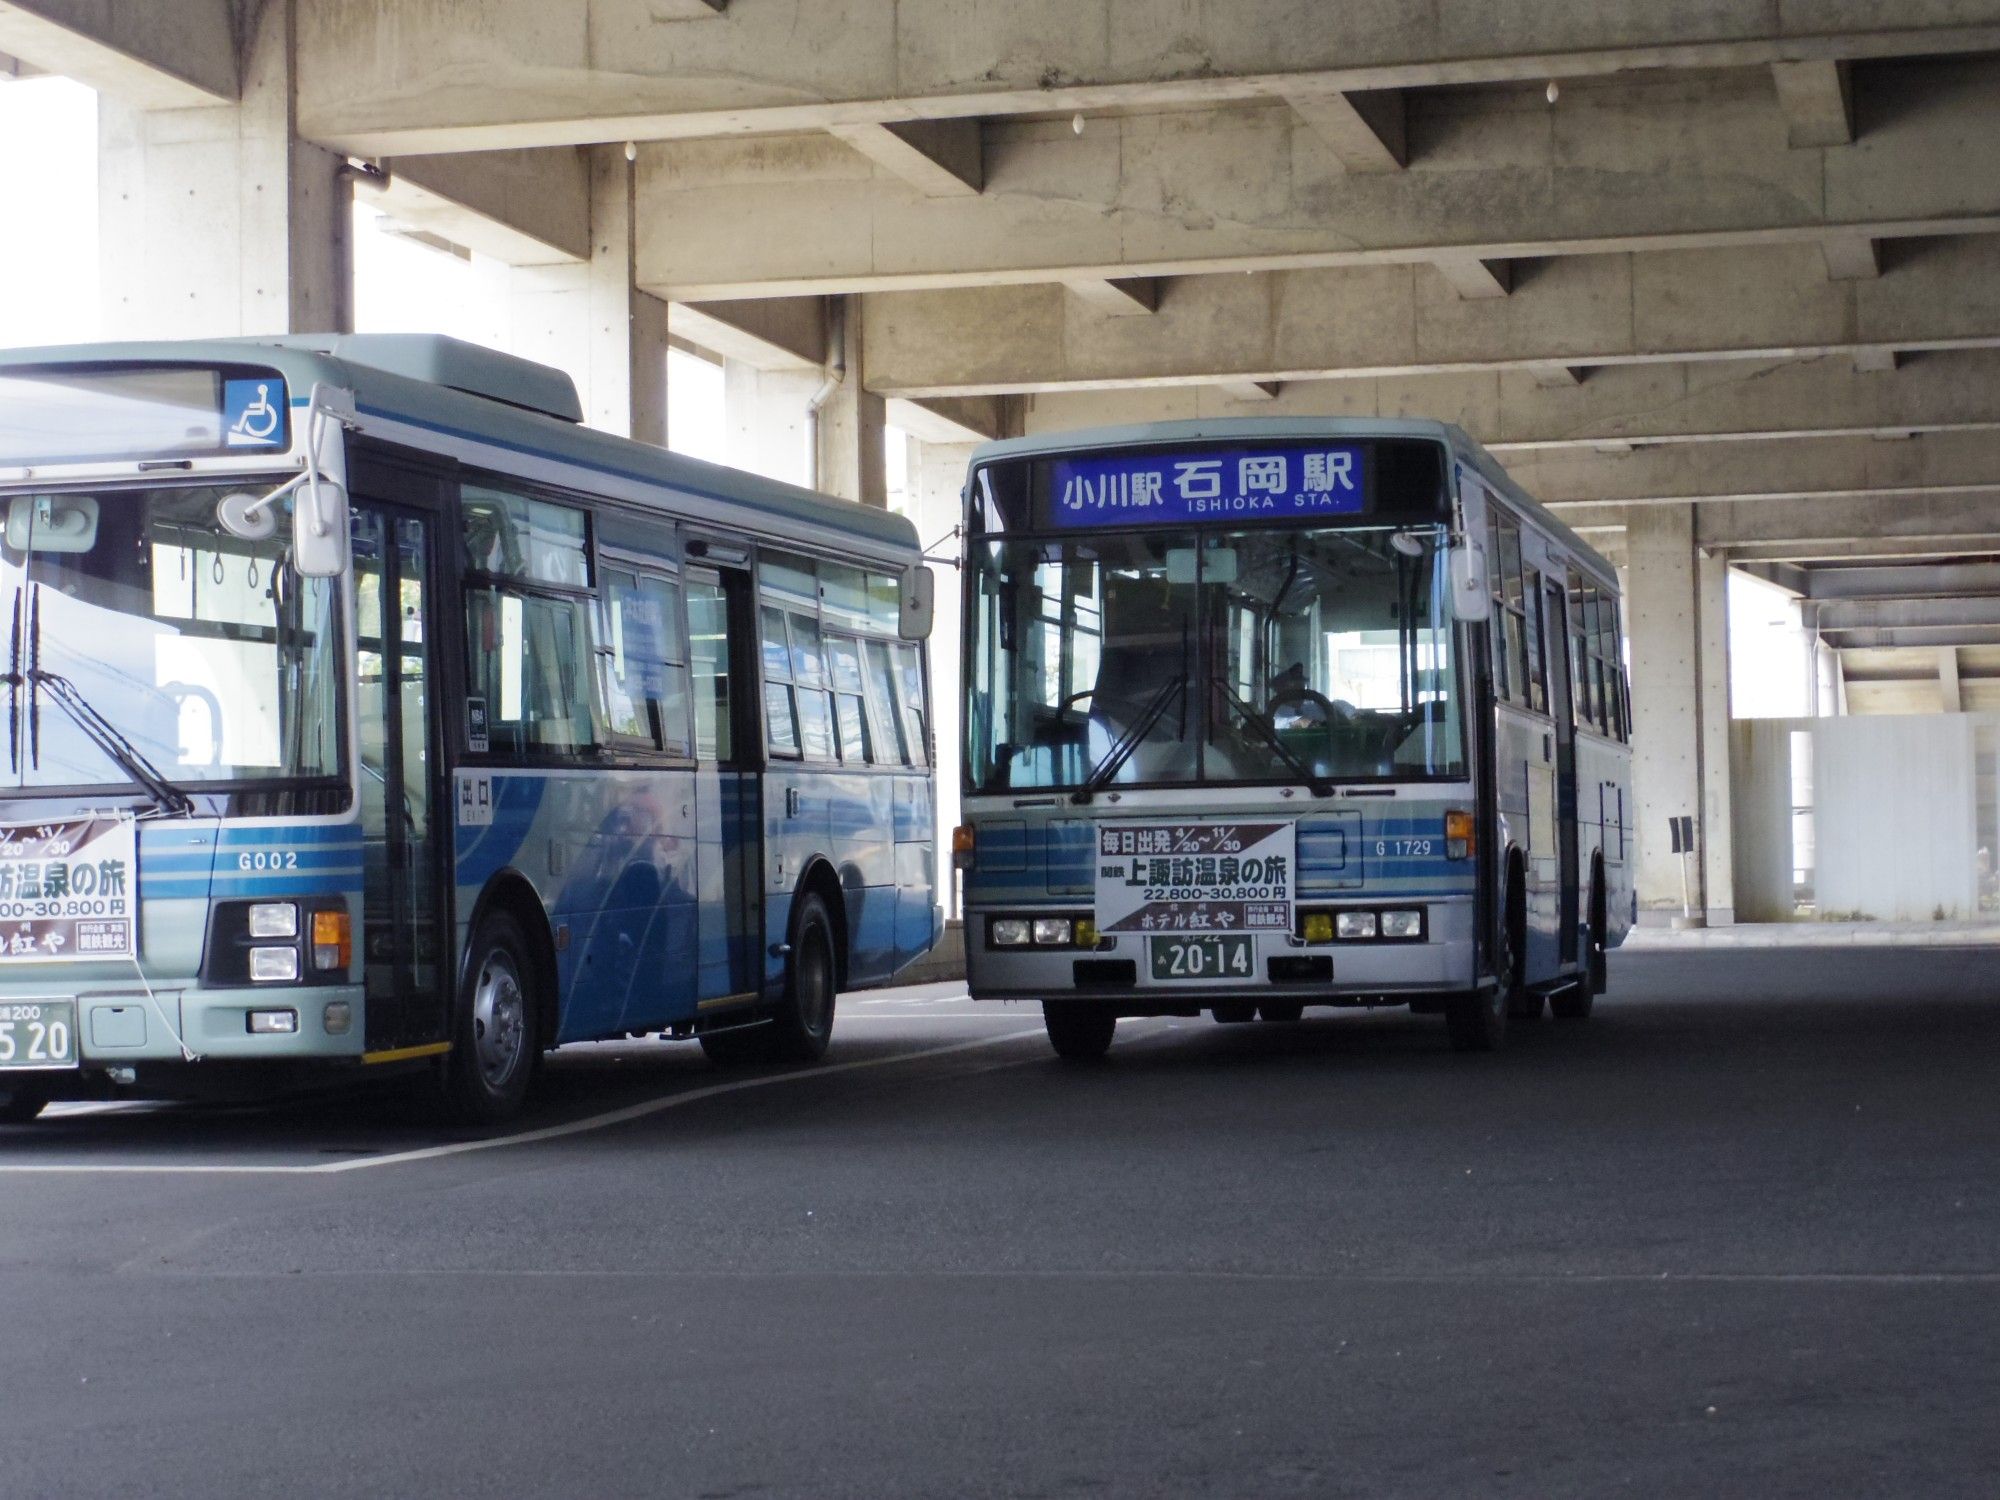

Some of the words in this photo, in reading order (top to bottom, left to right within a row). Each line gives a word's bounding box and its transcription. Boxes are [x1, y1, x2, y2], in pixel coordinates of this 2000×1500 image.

[1063, 472, 1163, 510] 小川駅
[1173, 451, 1354, 498] 石岡駅
[1188, 496, 1275, 512] ISHIOKA
[1294, 493, 1341, 507] STA.
[463, 779, 488, 805] 出口
[1103, 829, 1171, 853] 毎日出発
[1376, 841, 1386, 856] G
[1395, 840, 1431, 855] 1729
[239, 852, 298, 870] G002
[1125, 856, 1287, 886] 上諏訪温泉の旅
[1141, 911, 1235, 929] ホテル紅や
[1169, 943, 1248, 974] 20-14
